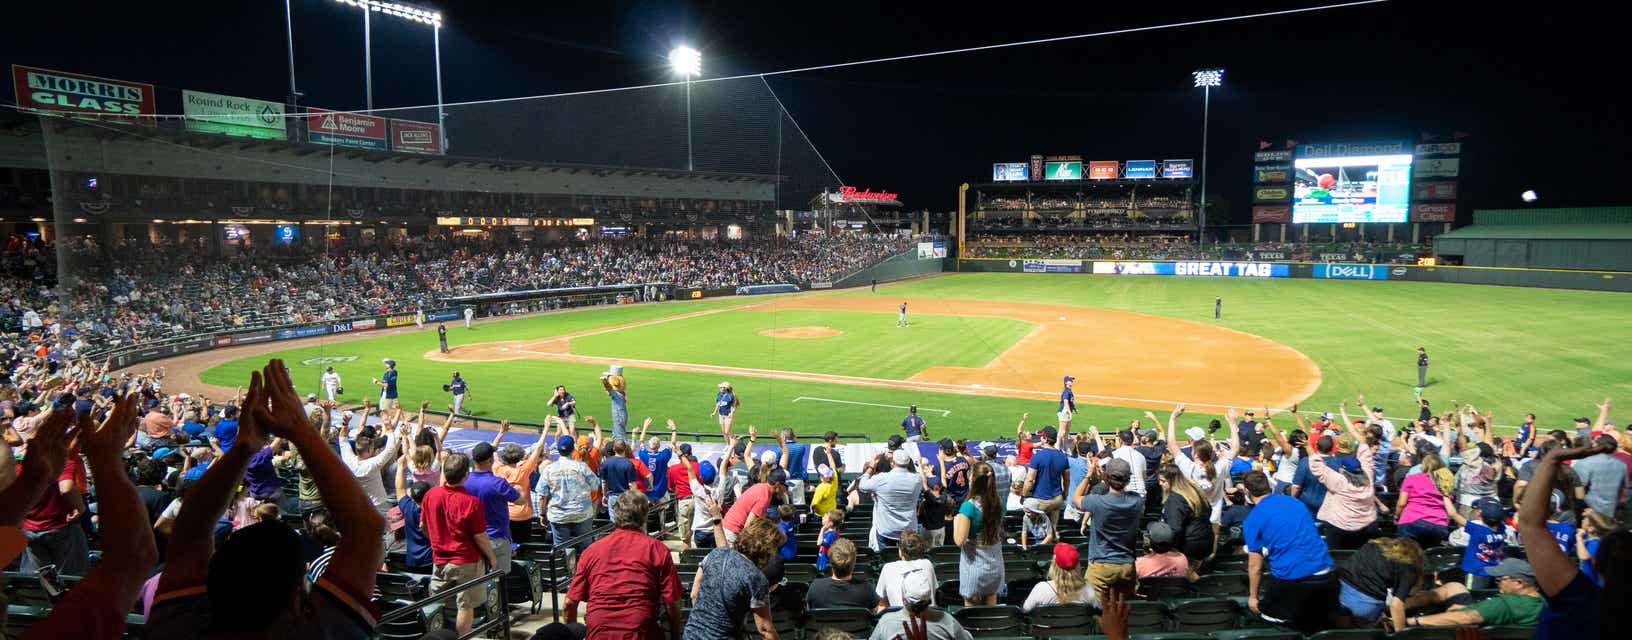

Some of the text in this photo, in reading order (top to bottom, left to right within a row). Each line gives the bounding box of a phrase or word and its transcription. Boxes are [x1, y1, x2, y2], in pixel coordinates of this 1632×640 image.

[31, 74, 142, 101] MORRIS
[31, 92, 141, 115] GLASS
[188, 94, 250, 112] Round Rock
[338, 115, 376, 127] Benjamin
[339, 124, 366, 134] Moore
[1305, 144, 1332, 157] Dell
[1336, 141, 1403, 155] Diamond
[840, 186, 897, 200] Budweiser
[1259, 252, 1284, 260] TEXAS
[1320, 253, 1346, 261] TEXAS
[1175, 262, 1272, 277] GREAT TAG
[1331, 265, 1370, 277] DELL
[332, 322, 353, 333] D&L
[648, 457, 657, 472] 5
[956, 470, 966, 487] 4
